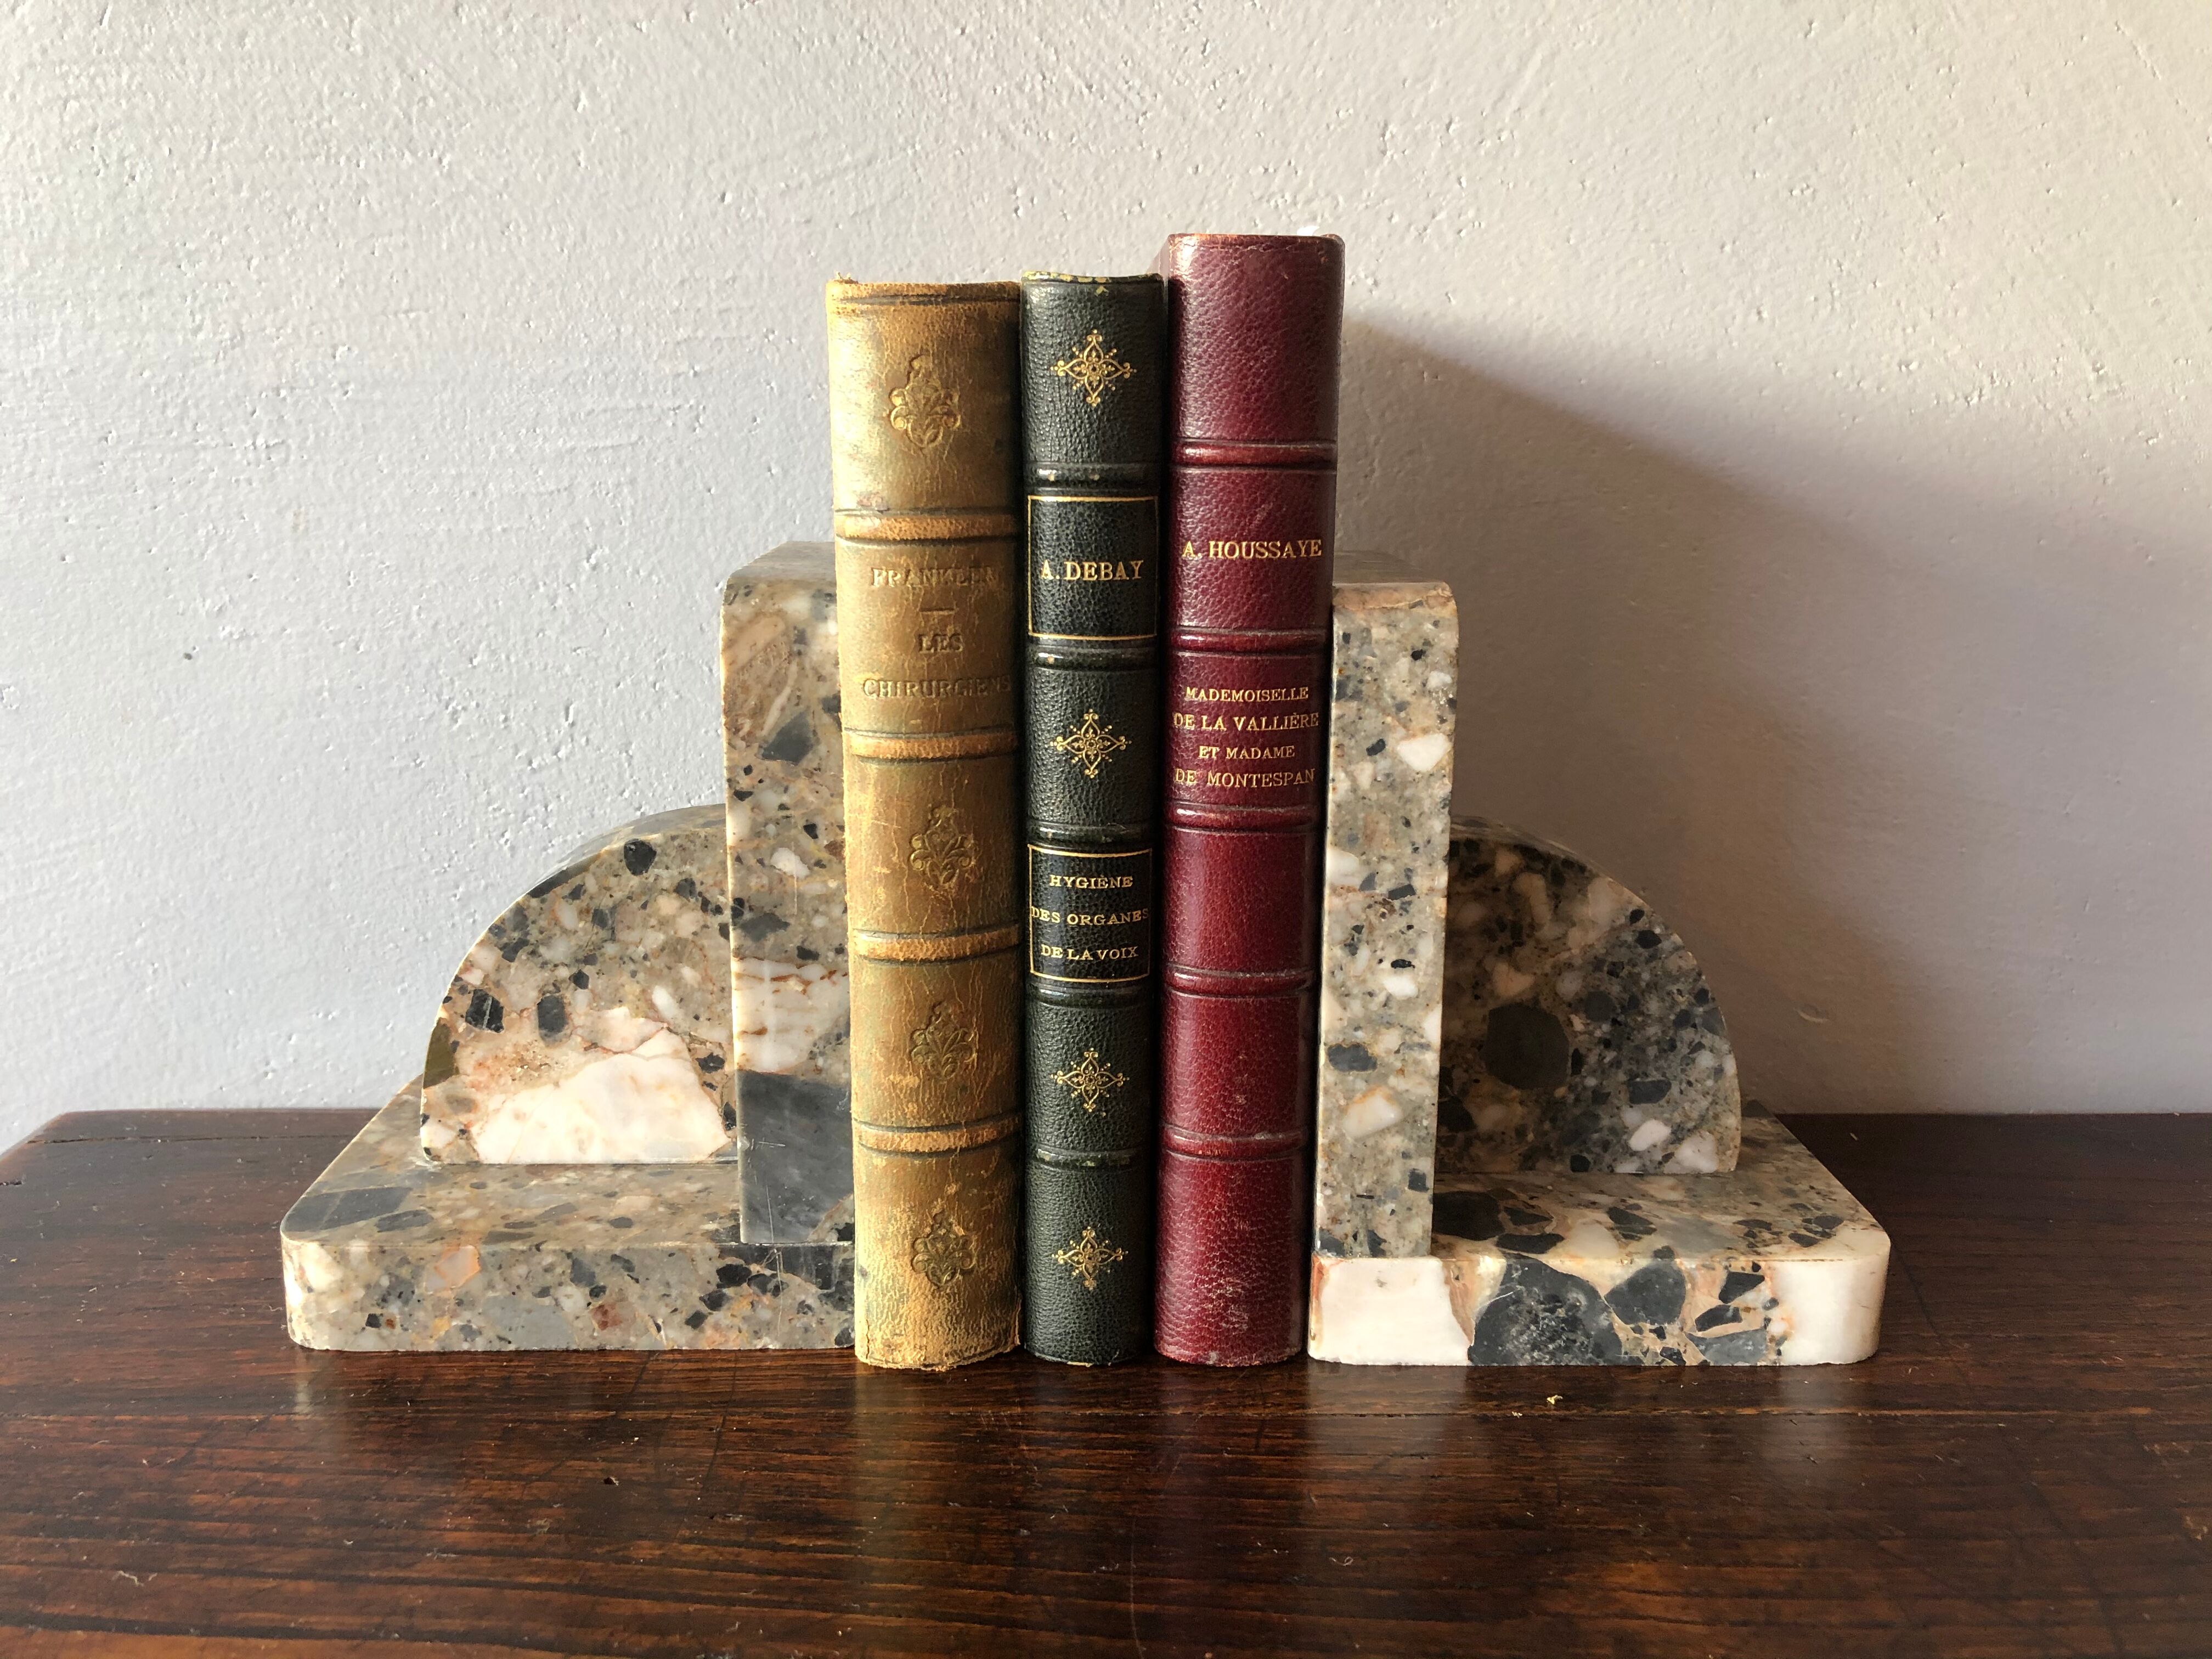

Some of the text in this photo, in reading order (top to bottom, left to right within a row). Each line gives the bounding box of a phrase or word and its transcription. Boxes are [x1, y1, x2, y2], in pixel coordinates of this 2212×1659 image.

[1182, 539, 1322, 559] A. HOUSSAYE
[1041, 559, 1144, 581] A. DEBAY
[918, 633, 964, 653] LES
[863, 674, 1011, 697] CHIRURGIENS
[1184, 686, 1309, 702] MADEMOISELLE
[1173, 713, 1319, 731] DE LA VALLIÈRE
[1198, 745, 1295, 759] ET MADAME
[1175, 768, 1315, 788] DE MONTESPAN
[1049, 874, 1133, 889] HYGIÈNE
[1030, 906, 1149, 926] DES ORGANES
[1041, 944, 1139, 961] DE LA VOIX
